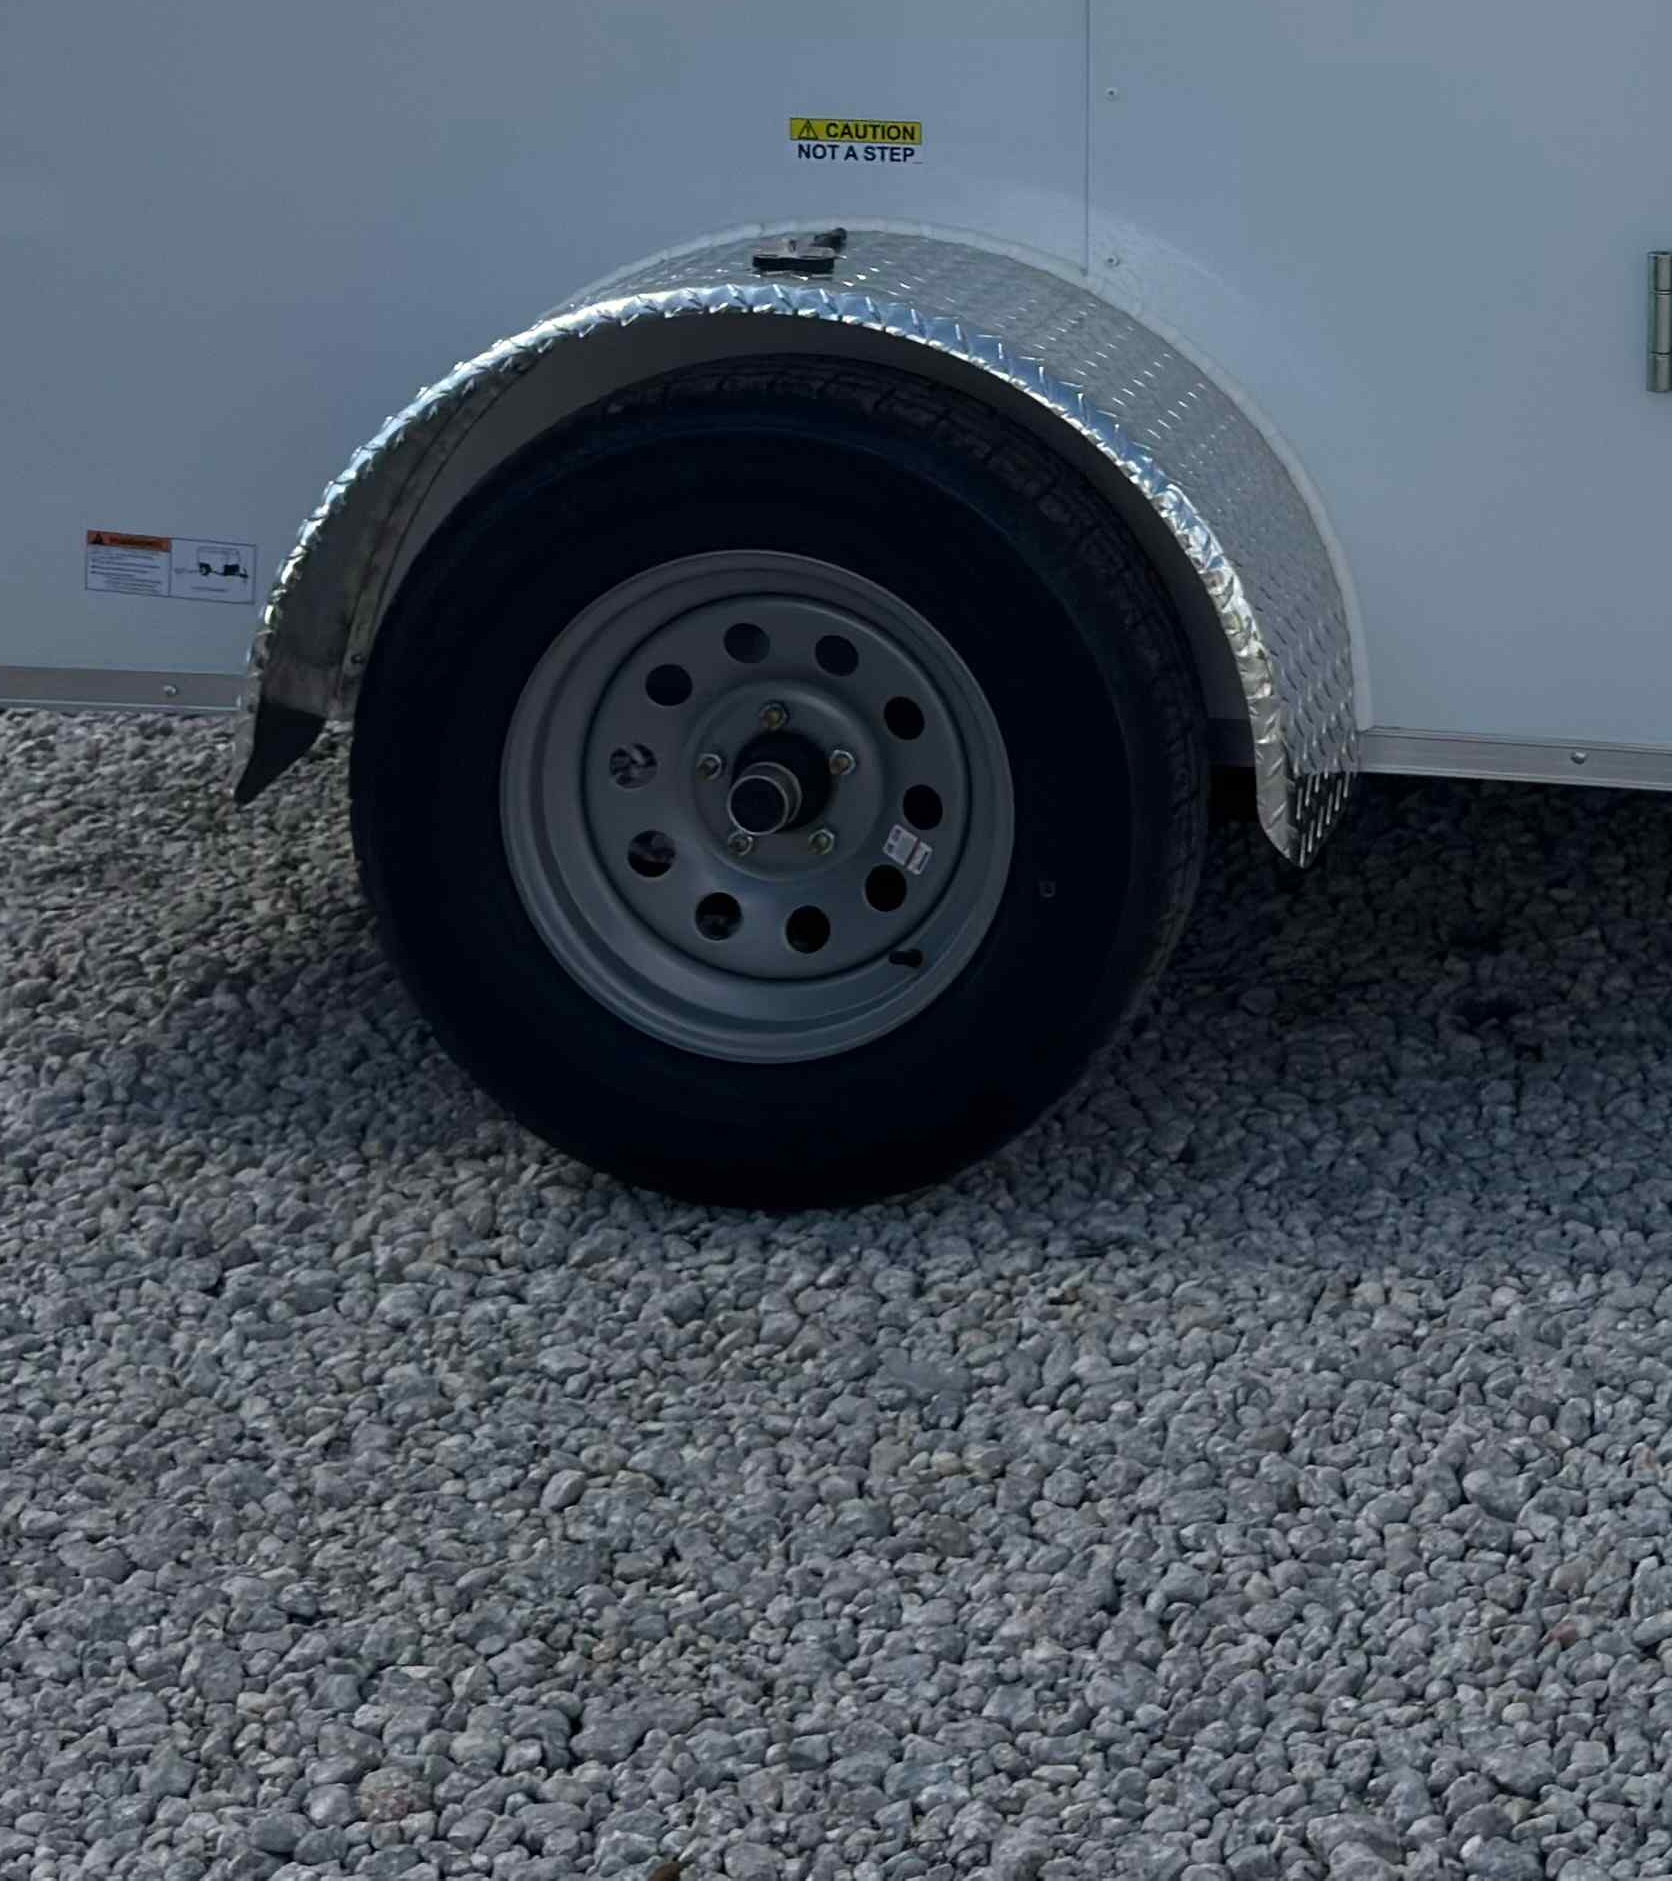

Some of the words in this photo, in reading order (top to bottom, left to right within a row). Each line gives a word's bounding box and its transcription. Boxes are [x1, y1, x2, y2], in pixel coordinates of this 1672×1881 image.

[826, 123, 915, 140] CAUTION
[798, 144, 839, 159] NOT
[844, 145, 858, 161] A
[863, 146, 915, 162] STEP
